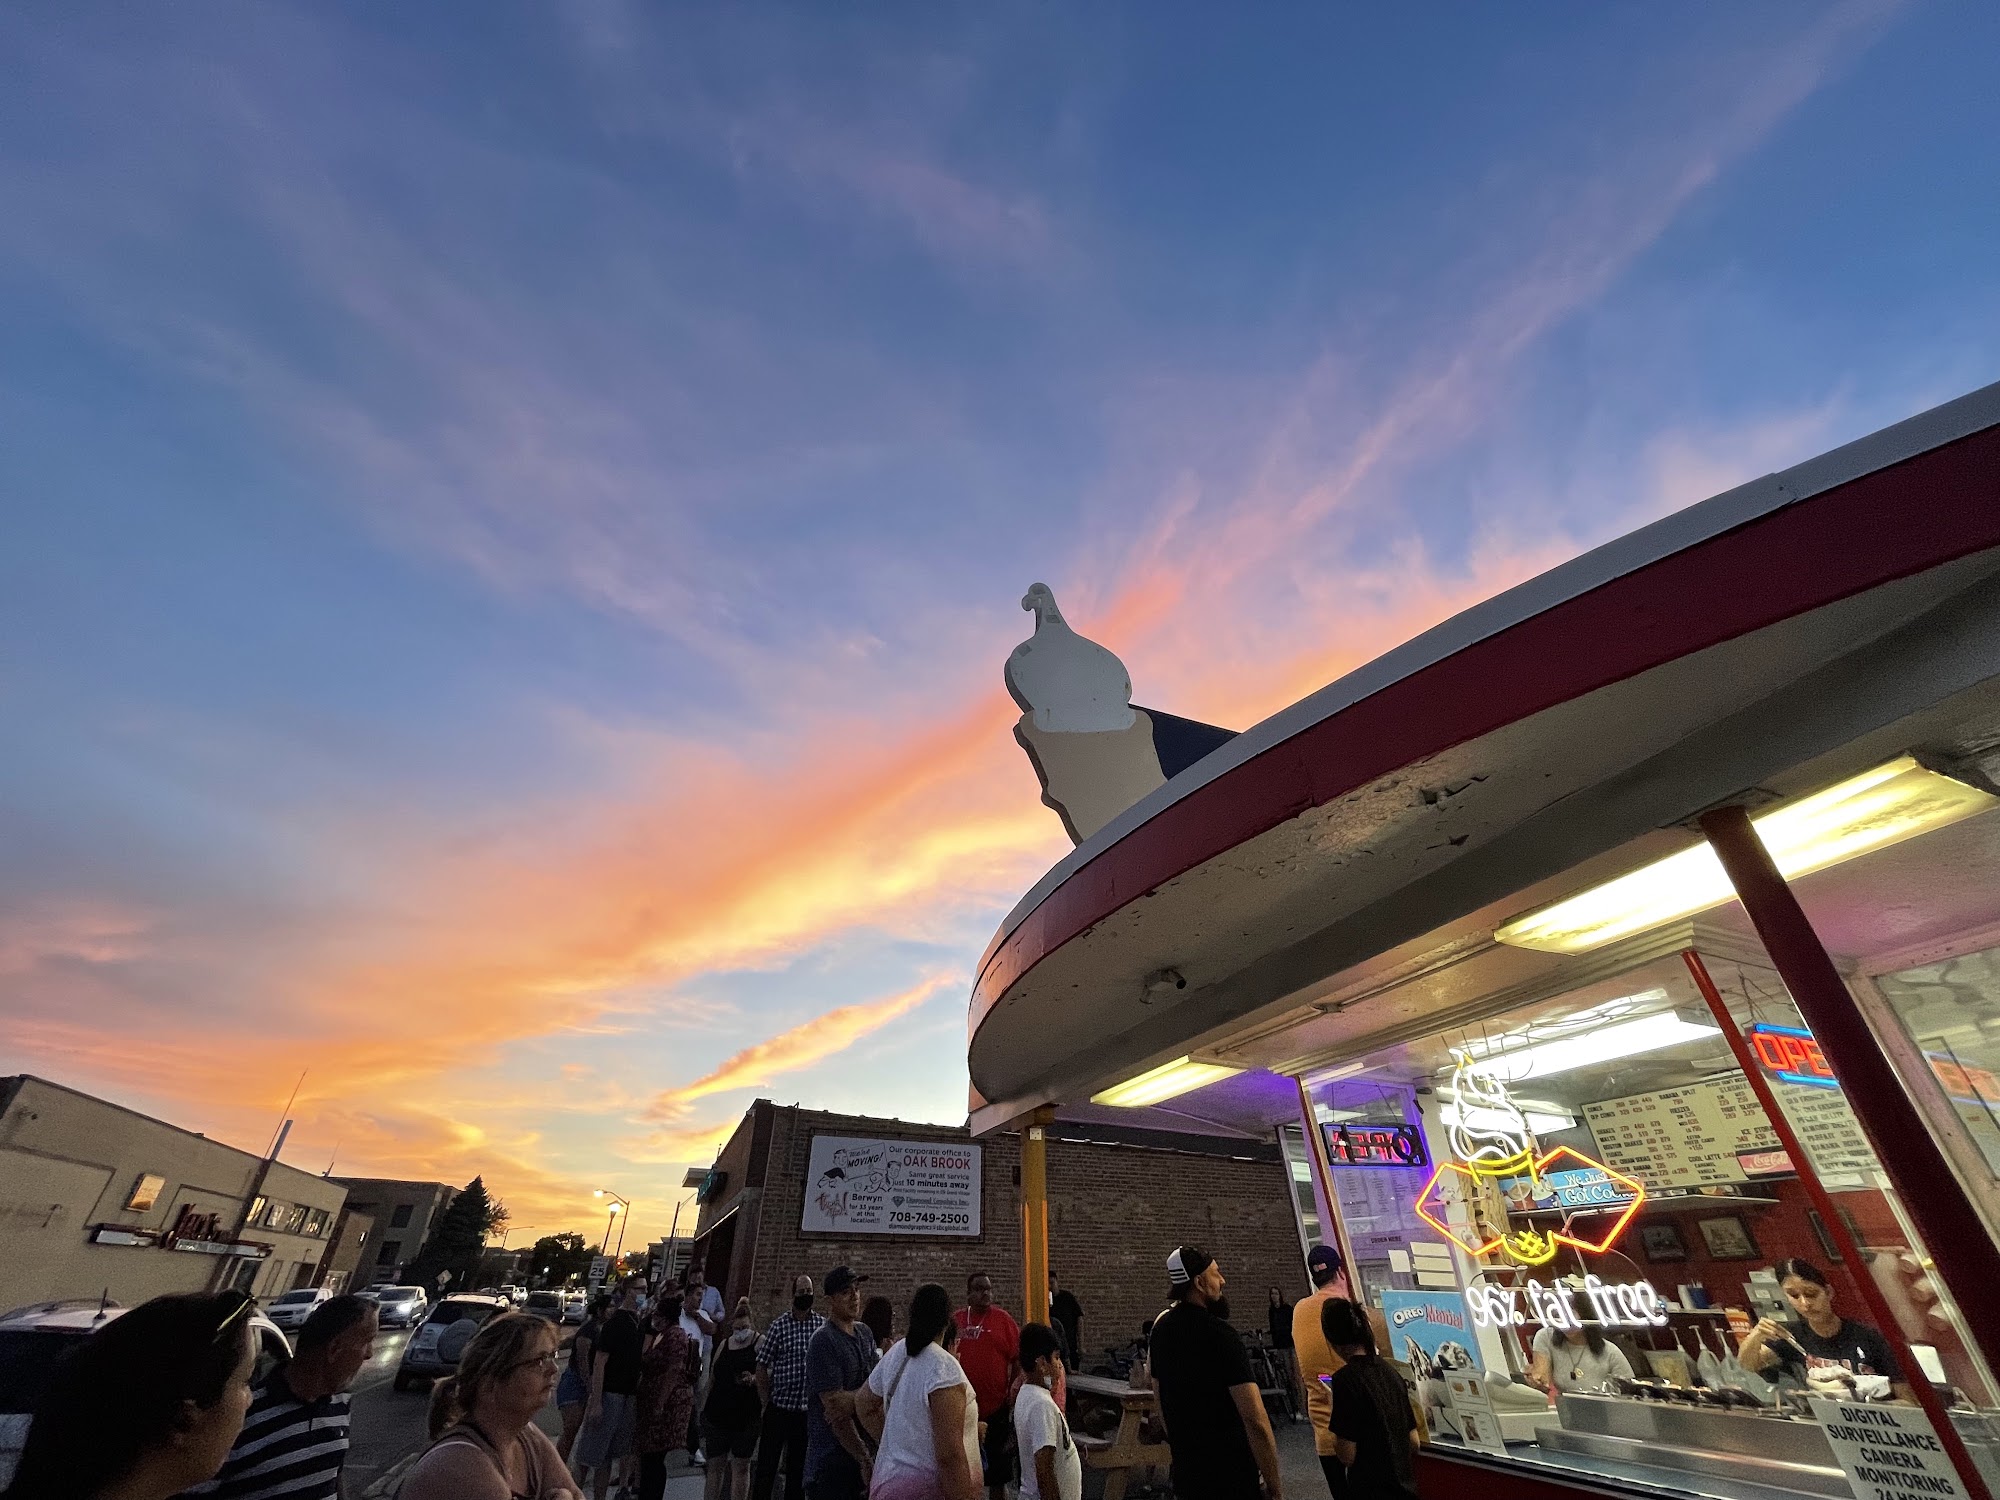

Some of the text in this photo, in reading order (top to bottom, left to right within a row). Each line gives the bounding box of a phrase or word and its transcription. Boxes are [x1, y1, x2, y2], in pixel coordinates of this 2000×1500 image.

[1752, 1033, 1833, 1077] OPE
[848, 1152, 883, 1167] MOVING!
[904, 1155, 970, 1169] OAK BROOK
[1565, 1174, 1580, 1185] We
[852, 1194, 882, 1203] Berwyn
[1565, 1186, 1590, 1203] Got
[890, 1212, 969, 1223] 708-749-2500
[590, 1268, 604, 1276] 25
[1466, 1274, 1668, 1329] 96% fat free
[1394, 1309, 1423, 1324] OREO
[1840, 1407, 1901, 1428] DIGITAL
[1826, 1424, 1941, 1452] SURVEILLANCE
[1860, 1448, 1926, 1470] CAMERA
[1854, 1466, 1954, 1495] MONITORING
